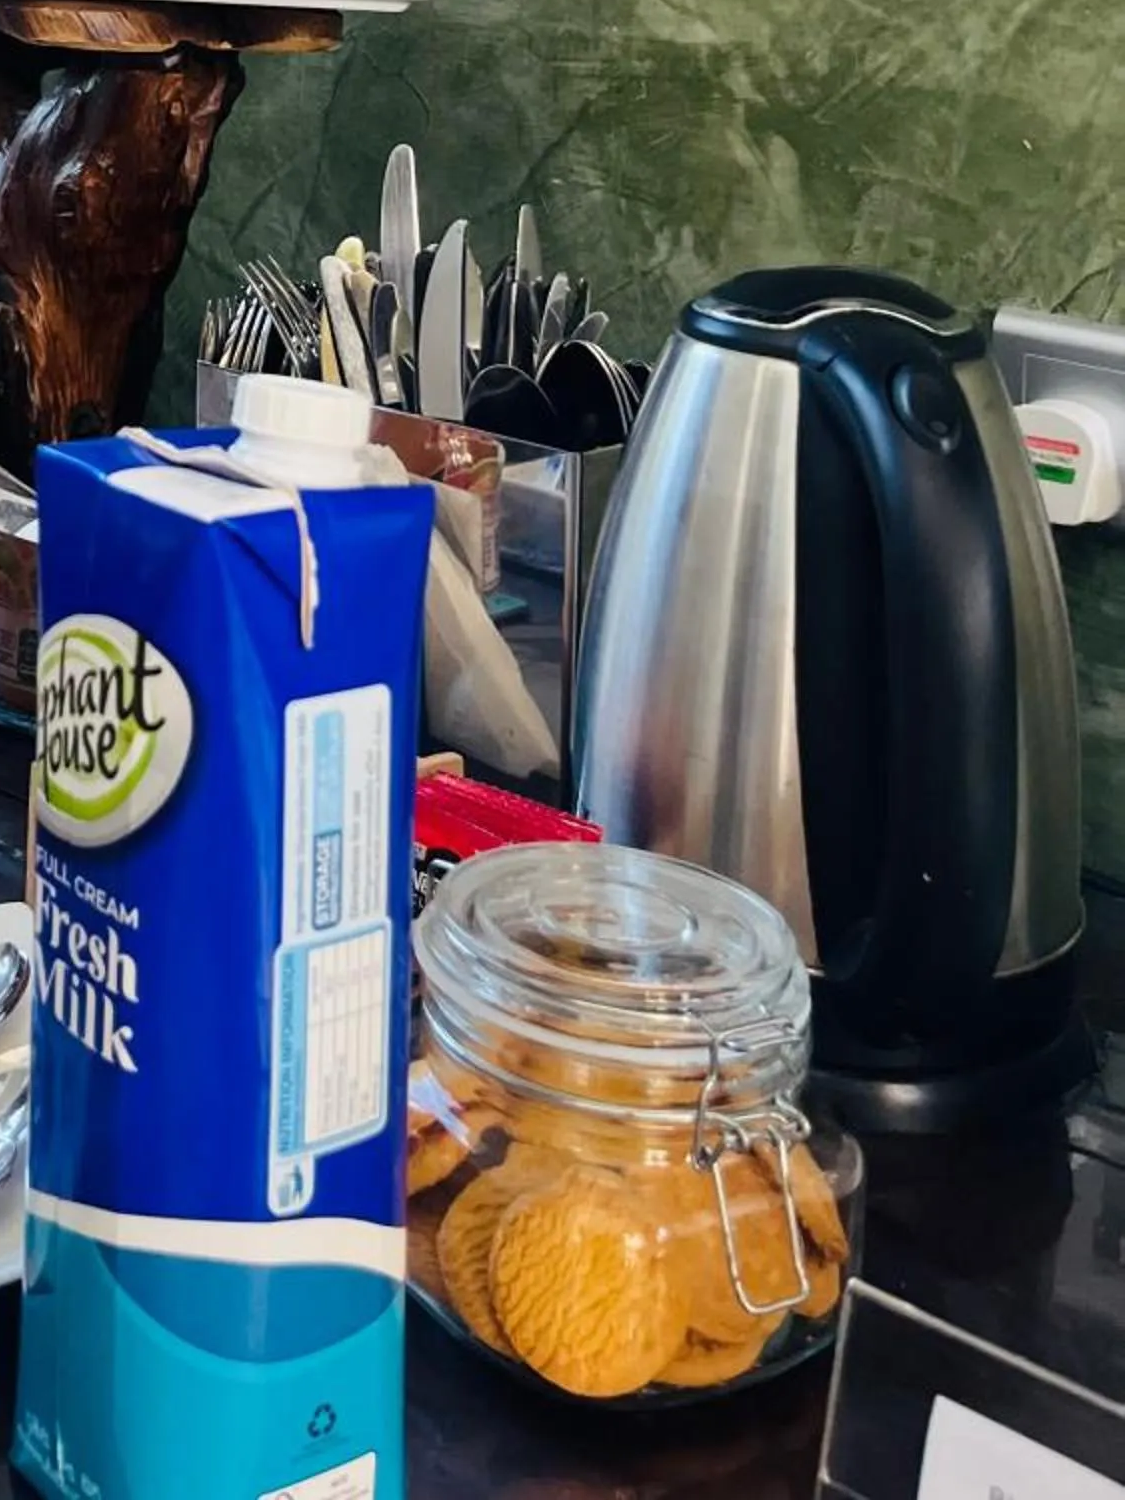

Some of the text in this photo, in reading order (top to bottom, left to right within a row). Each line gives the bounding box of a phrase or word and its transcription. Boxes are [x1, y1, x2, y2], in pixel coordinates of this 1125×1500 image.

[34, 873, 140, 1004] Fresh
[36, 844, 140, 931] FULL CREAM
[34, 937, 139, 1074] Milk
